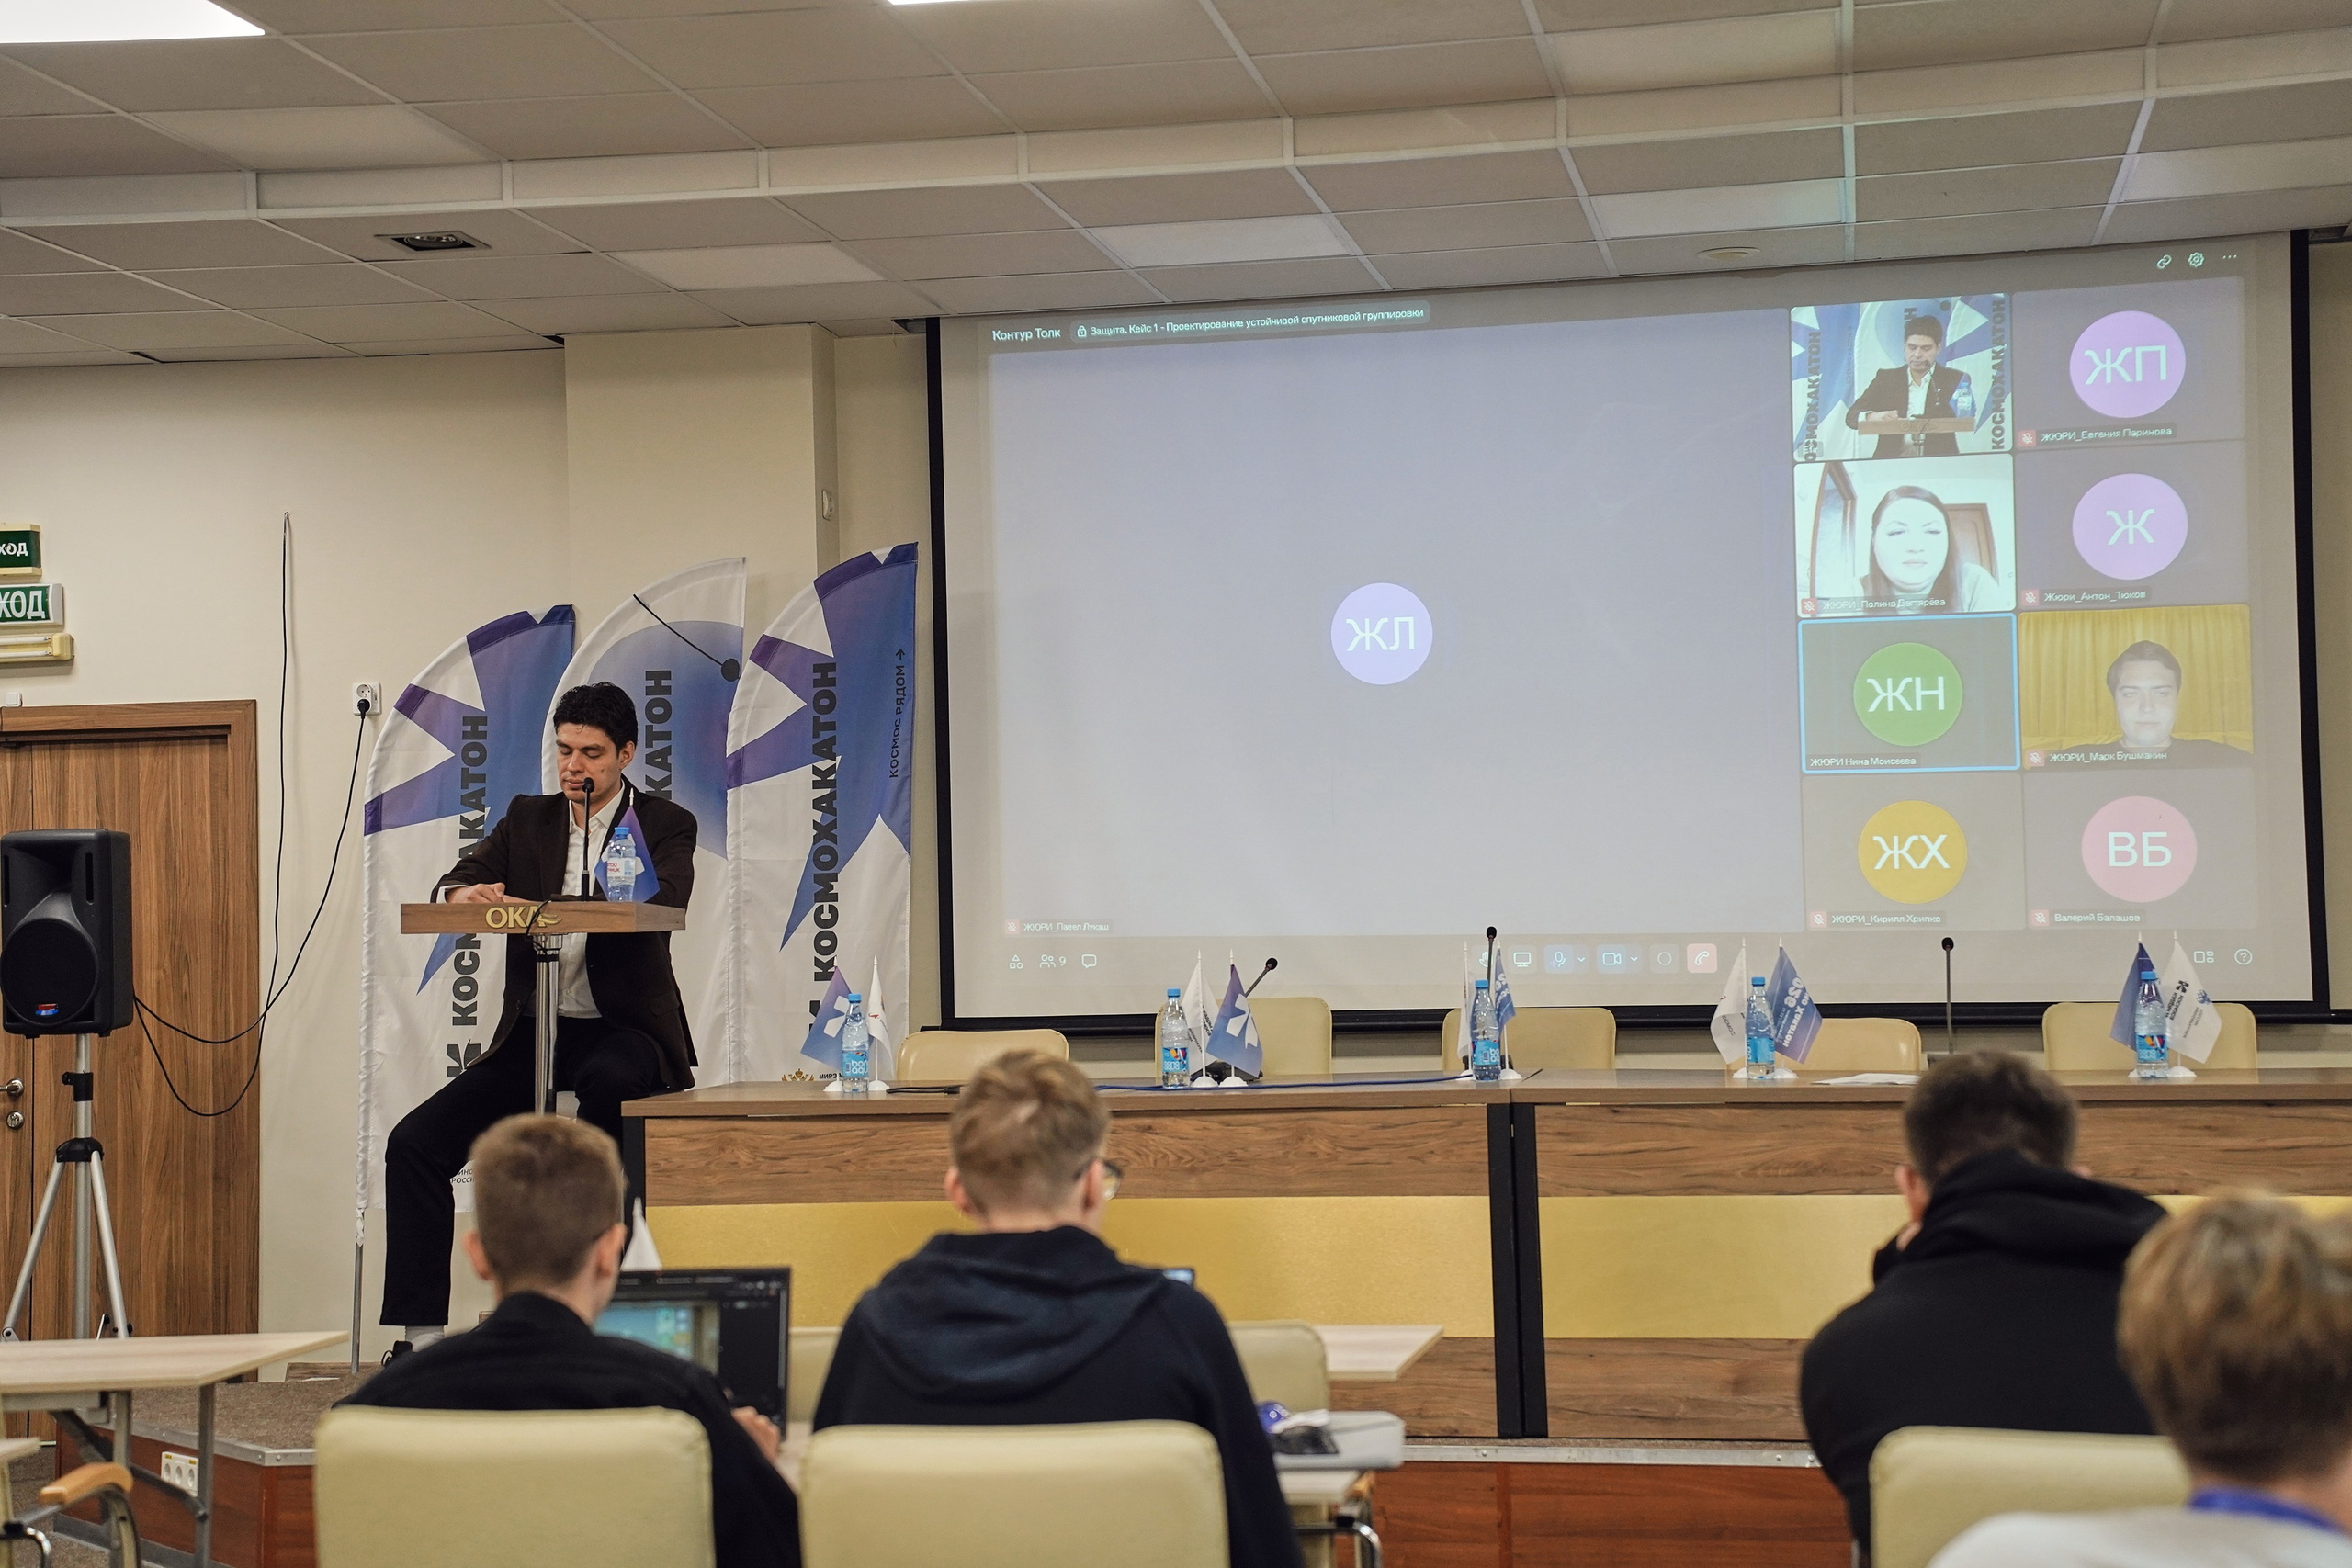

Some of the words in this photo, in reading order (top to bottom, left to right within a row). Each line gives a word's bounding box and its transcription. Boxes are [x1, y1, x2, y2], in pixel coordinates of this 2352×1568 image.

[992, 329, 1033, 342] Контур
[1035, 327, 1061, 339] Толк
[1090, 325, 1127, 337] Защита.
[1129, 323, 1152, 334] Кейс
[1166, 320, 1244, 333] Проектирование
[1245, 315, 1299, 330] устойчивой
[1301, 311, 1361, 326] спутниковой
[1363, 309, 1424, 321] группировки
[2084, 345, 2168, 386] ЖП
[2041, 429, 2121, 442] ЖЮРИ_Евгения
[2122, 427, 2173, 438] Паринова
[2105, 508, 2156, 546] Ж
[0, 542, 28, 557] ХОД
[0, 590, 46, 620] ХОД
[1345, 616, 1416, 652] ЖЛ
[1866, 676, 1945, 713] ЖН
[889, 718, 901, 778] КОСМОС
[895, 665, 907, 716] РЯДОМ
[1810, 758, 1844, 767] ЖЮРИ
[1845, 757, 1869, 766] Нина
[1870, 757, 1917, 766] Моисеева
[2049, 750, 2115, 763] ЖЮРИ_Марк
[2116, 750, 2167, 761] Бушмакин
[812, 662, 838, 981] КОСМОХАКАТОН
[1872, 834, 1951, 871] ЖХ
[2108, 831, 2172, 868] ВБ
[485, 906, 547, 930] ОКА
[1023, 922, 1081, 932] ЖЮРИ_Павел
[1082, 922, 1109, 931] Лукаш
[1831, 914, 1905, 926] ЖЮРИ_Кирилл
[1905, 913, 1941, 924] Хрипко
[2053, 913, 2096, 923] Валерий
[2097, 913, 2141, 922] Балашов
[1058, 955, 1067, 967] 9
